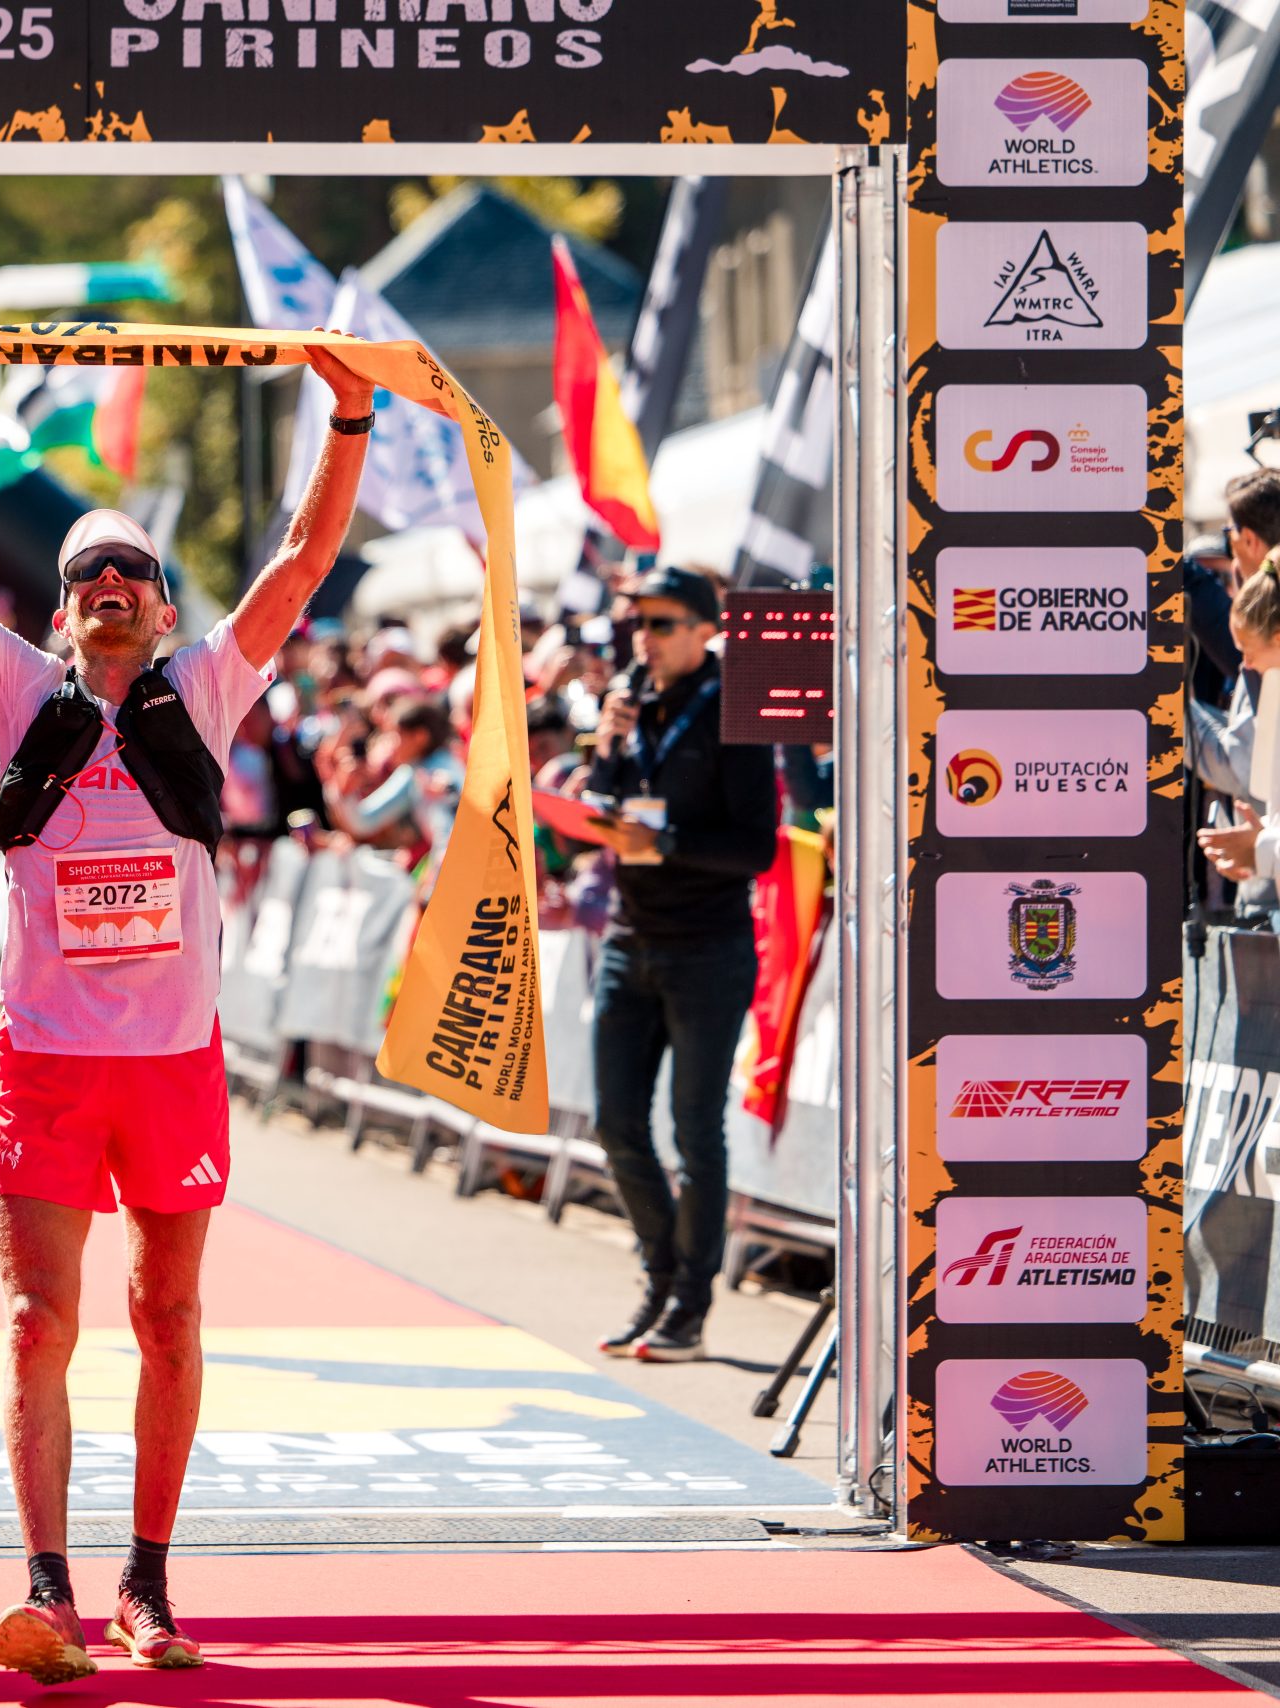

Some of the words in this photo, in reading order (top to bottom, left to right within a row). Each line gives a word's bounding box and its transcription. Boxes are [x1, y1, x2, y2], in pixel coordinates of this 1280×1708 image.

[110, 28, 604, 69] PIRINEOS
[1004, 138, 1075, 154] WORLD
[993, 260, 1016, 289] IAU
[1066, 251, 1099, 301] WMRA
[1013, 297, 1074, 311] WMTRC
[1026, 329, 1063, 342] ITRA
[1070, 444, 1106, 456] Consejo
[1070, 455, 1108, 464] Superior
[1070, 464, 1081, 472] de
[1084, 464, 1124, 474] Deportes
[999, 587, 1129, 608] GOBIERNO
[999, 611, 1031, 631] DE
[1040, 611, 1147, 631] ARAGON
[149, 693, 177, 707] TERREX
[1015, 758, 1129, 776] DIPUTACIÓN
[1015, 778, 1129, 793] HUESCA
[68, 864, 141, 876] SHORTTRAIL
[143, 861, 164, 872] 45K
[88, 884, 147, 906] 2072
[426, 896, 509, 1079] CANFRANC
[465, 894, 520, 1090] PIRINEOS
[493, 1051, 516, 1097] WORLD
[508, 973, 528, 1048] MOUNTAIN
[521, 937, 531, 968] AND
[509, 1042, 531, 1101] RUNNING
[1015, 1080, 1131, 1106] RFEA
[1009, 1106, 1120, 1117] ATLETISMO
[1030, 1233, 1117, 1249] FEDERACIÓN
[1024, 1251, 1107, 1264] ARAGONESA
[1111, 1251, 1131, 1264] DE
[1017, 1268, 1136, 1286] ATLETISMO
[1001, 1438, 1073, 1453] WORLD
[368, 1471, 742, 1483] TRAIL
[472, 1480, 749, 1492] 2025
